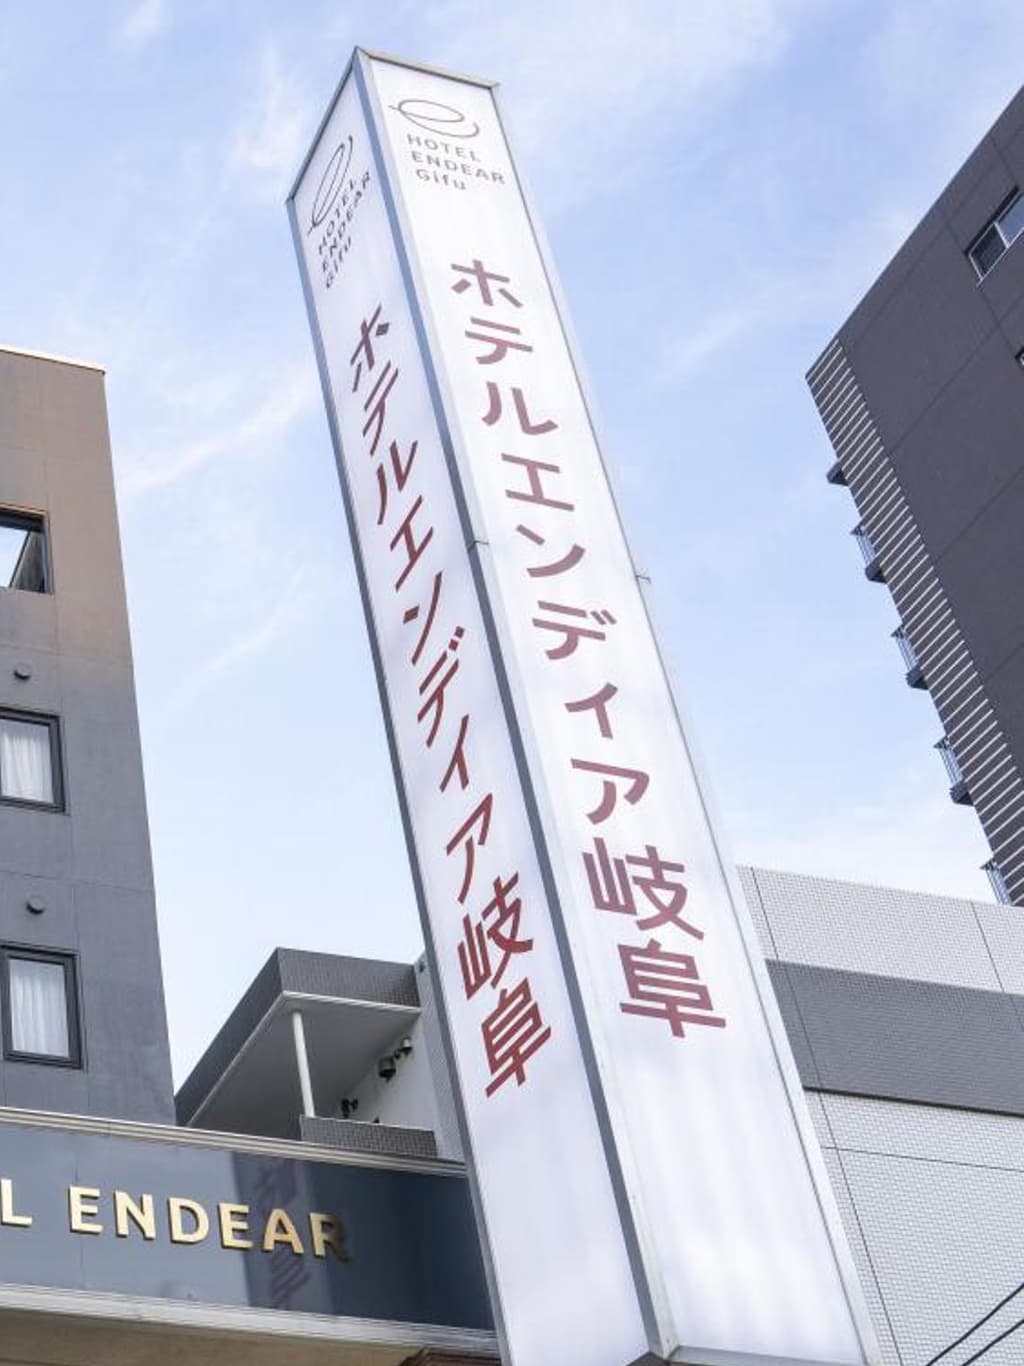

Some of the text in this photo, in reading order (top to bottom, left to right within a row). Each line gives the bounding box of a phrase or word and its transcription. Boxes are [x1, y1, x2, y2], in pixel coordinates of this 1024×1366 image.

[407, 134, 481, 162] HOTEL
[412, 151, 505, 184] ENDEAR
[416, 169, 466, 190] Gifu
[450, 258, 726, 1040] ホテルエンディア岐阜
[350, 302, 553, 1098] ホテルエンディア岐阜
[70, 1186, 348, 1261] ENDEAR
